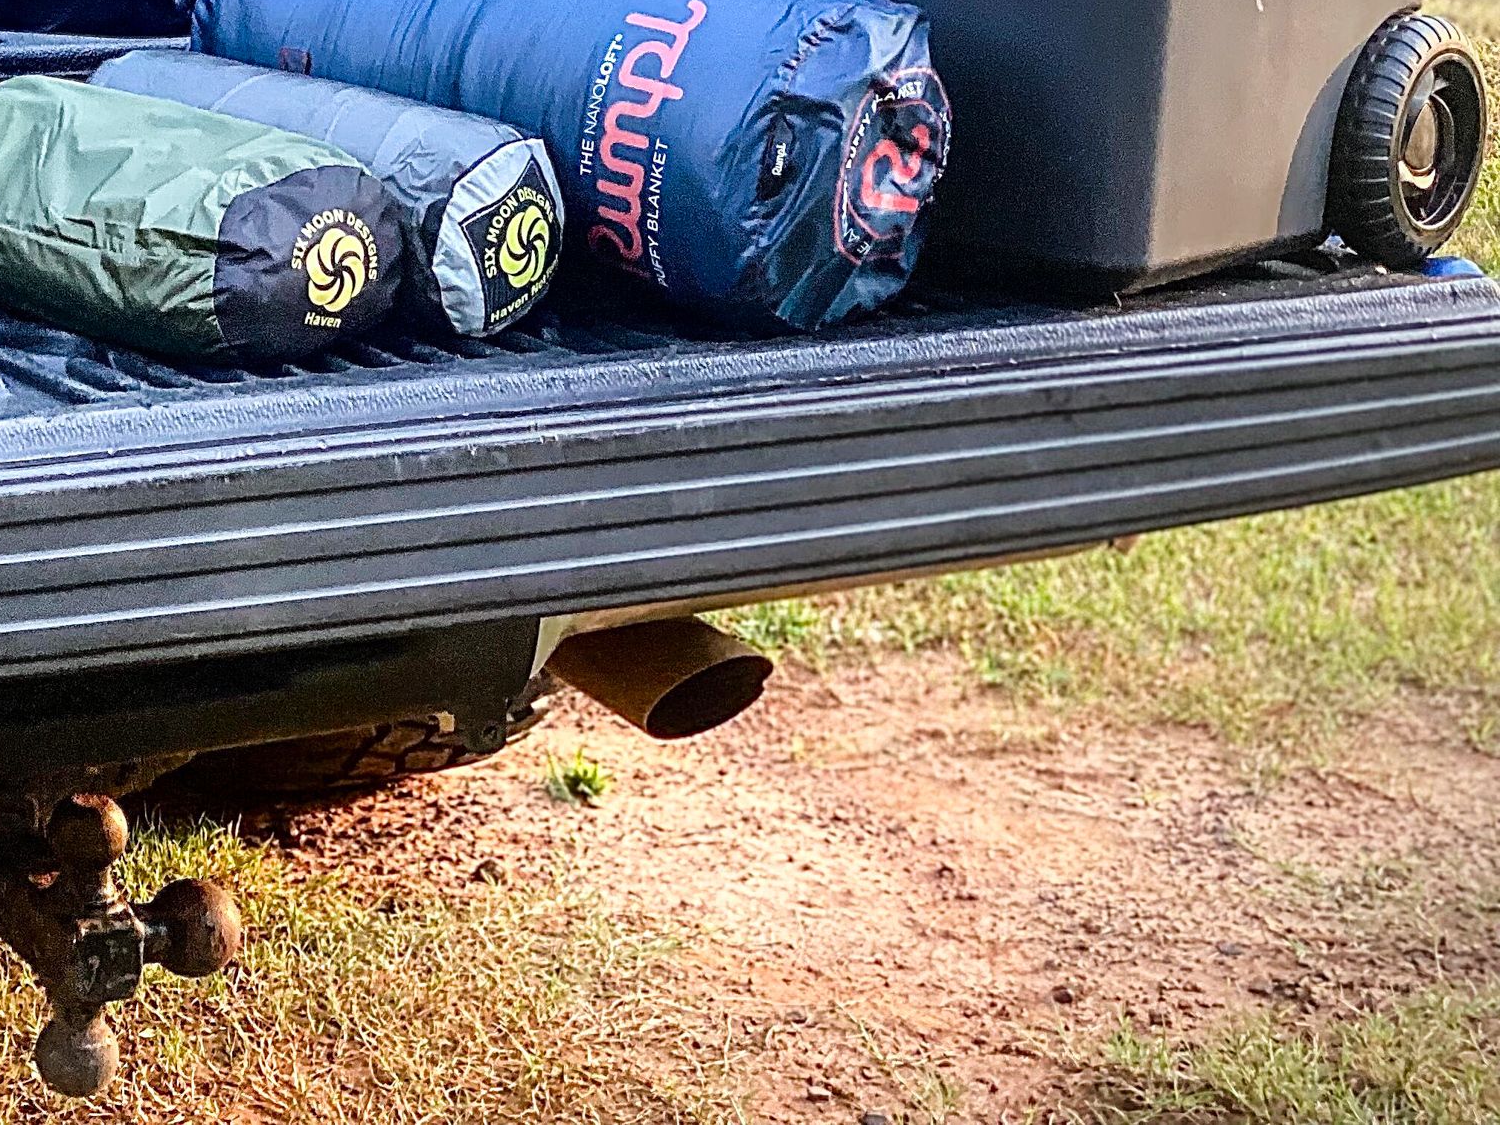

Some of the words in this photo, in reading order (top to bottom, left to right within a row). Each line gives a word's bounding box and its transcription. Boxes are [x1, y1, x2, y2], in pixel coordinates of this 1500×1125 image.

[586, 39, 624, 136] NANOLOFT
[579, 138, 595, 176] THE
[516, 186, 554, 223] DESIGNS
[647, 137, 669, 232] BLANKET
[486, 195, 519, 243] MOON
[291, 236, 308, 269] SIX
[301, 209, 344, 239] MOON
[346, 212, 378, 280] DESIGNS
[485, 247, 498, 279] SIX
[647, 235, 669, 288] PUFFY
[303, 311, 342, 328] Haven
[491, 292, 529, 323] Haven
